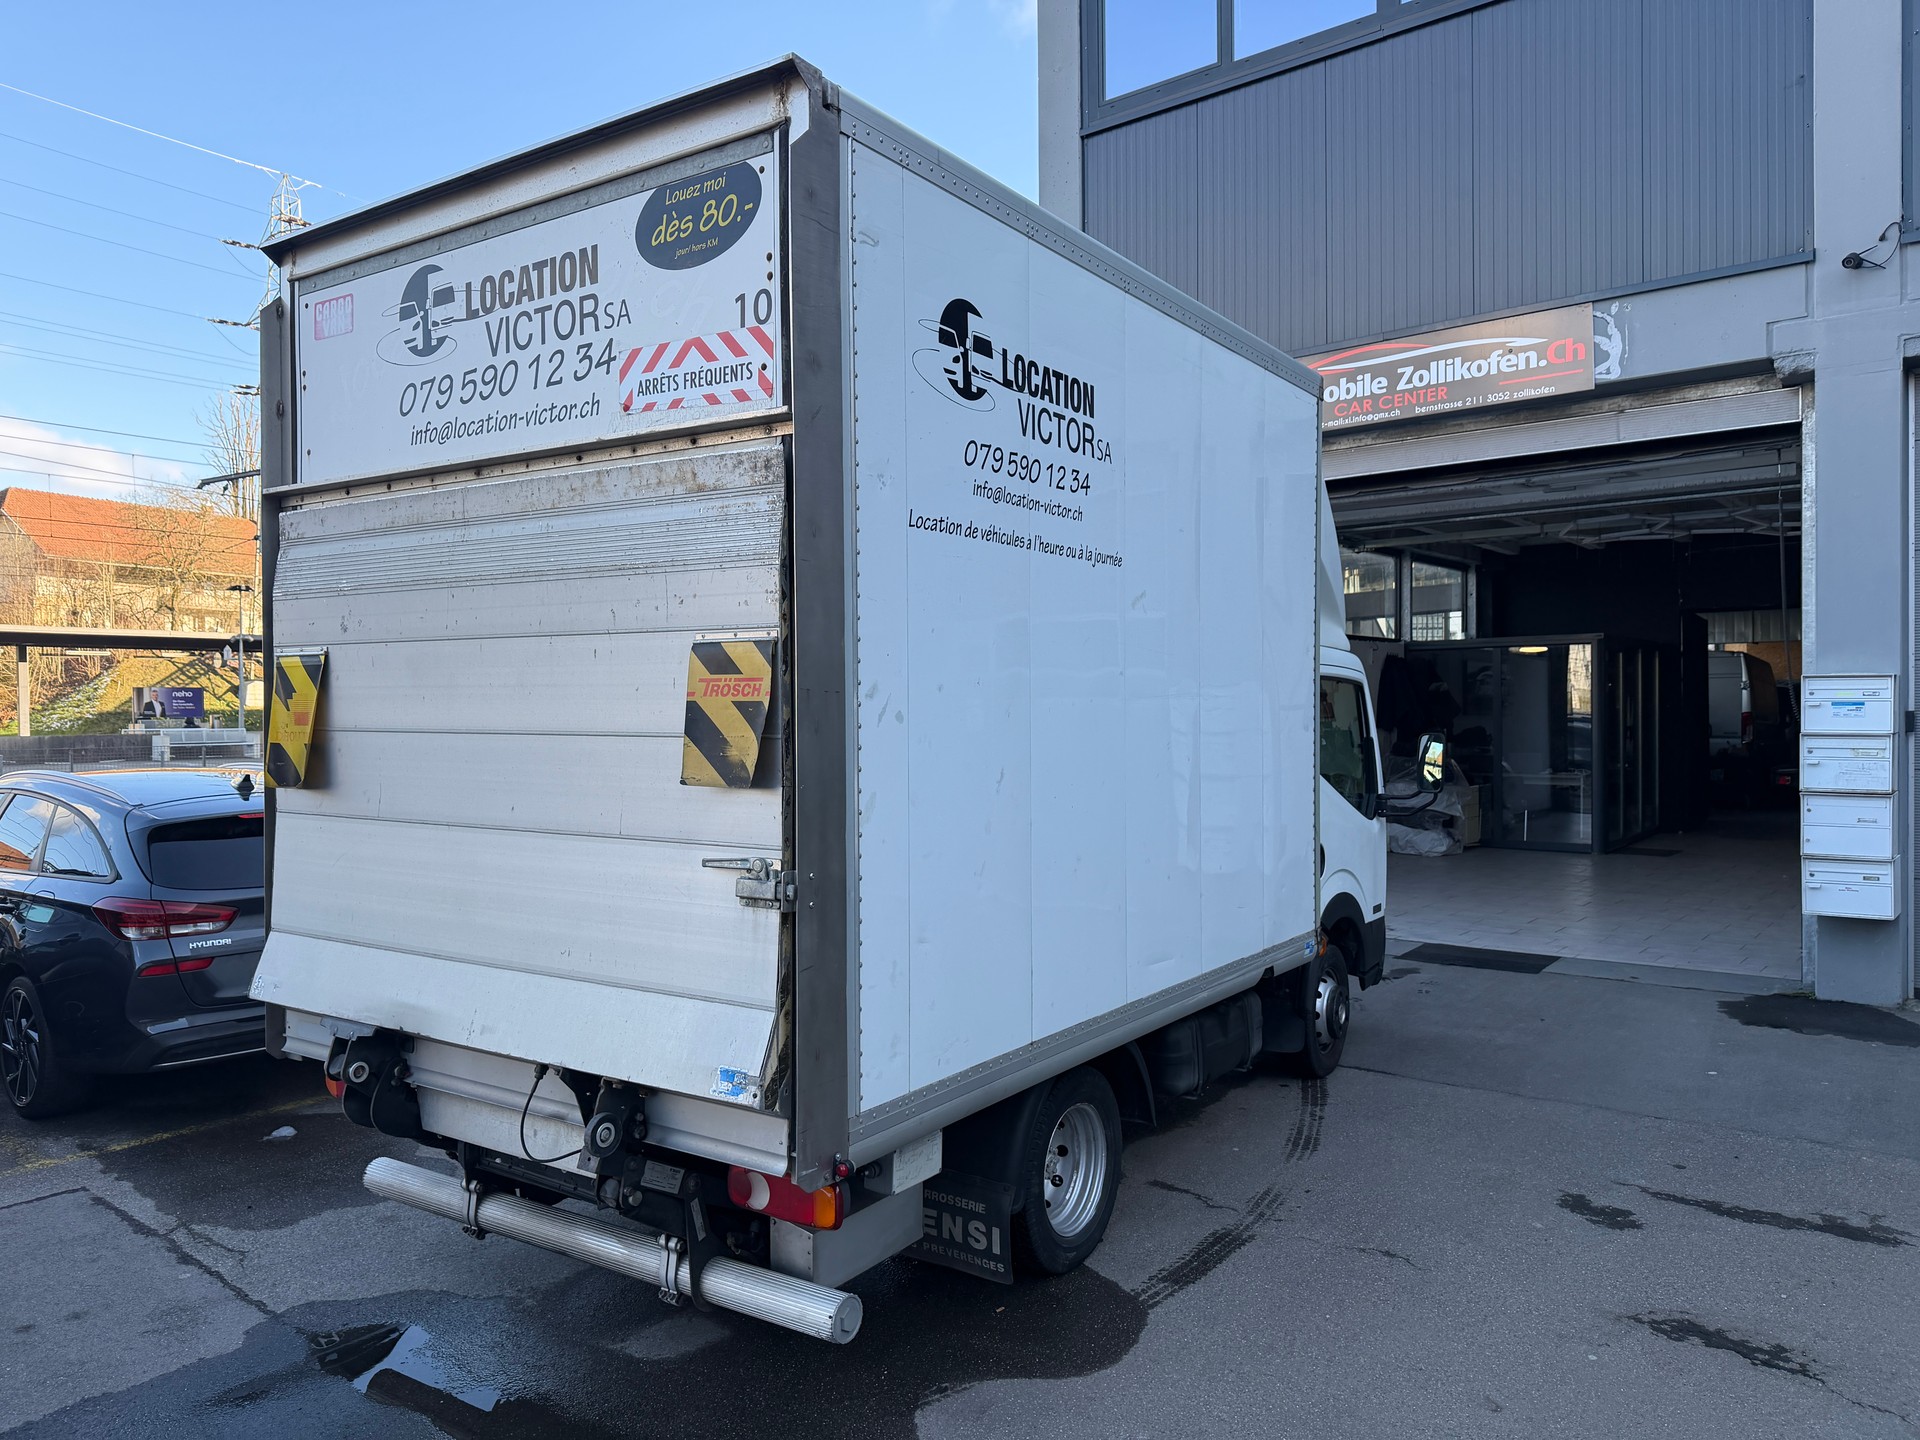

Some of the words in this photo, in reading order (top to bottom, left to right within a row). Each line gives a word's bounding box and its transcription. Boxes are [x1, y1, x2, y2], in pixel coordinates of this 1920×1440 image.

[665, 184, 701, 206] Louez
[703, 171, 727, 194] moi
[651, 210, 693, 246] dès
[699, 193, 754, 232] 80.-
[691, 242, 707, 252] hors
[707, 237, 719, 247] KM
[465, 243, 599, 321] LOCATION
[316, 295, 352, 321] CARGO
[484, 293, 600, 358] VICTOR
[604, 299, 632, 330] SA
[734, 288, 773, 329] 10
[399, 373, 454, 417] 079
[459, 359, 519, 405] 590
[527, 349, 565, 390] 12
[573, 337, 617, 382] 34
[636, 372, 679, 398] ARRÊTS
[683, 361, 753, 390] FRÉQUENTS
[1001, 347, 1095, 419] LOCATION
[1323, 373, 1388, 403] obile
[1396, 338, 1586, 391] Zollikofen.Ch
[410, 392, 601, 446] info@location-victor.ch
[1334, 399, 1373, 417] CAR
[1379, 386, 1448, 410] CENTER
[1415, 399, 1463, 414] bernstrasse
[1465, 397, 1483, 406] 211
[1486, 391, 1510, 403] 3052
[1513, 385, 1556, 399] zollikofen
[1017, 398, 1096, 460] VICTOR
[1096, 438, 1112, 465] SA
[963, 439, 1005, 474] 079
[1007, 451, 1042, 484] 590
[1045, 463, 1066, 491] 12
[1069, 472, 1091, 497] 34
[972, 479, 1083, 523] info@location-victor.ch
[908, 508, 962, 537] Location
[964, 520, 979, 540] de
[980, 524, 1025, 549] véhicules
[1026, 533, 1032, 551] à
[1065, 546, 1077, 559] ou
[1077, 543, 1084, 560] à
[1085, 544, 1093, 563] la
[1092, 549, 1123, 569] journée
[172, 690, 193, 698] neho
[698, 677, 764, 698] TRÖSCH
[189, 938, 232, 950] HYUNDAI
